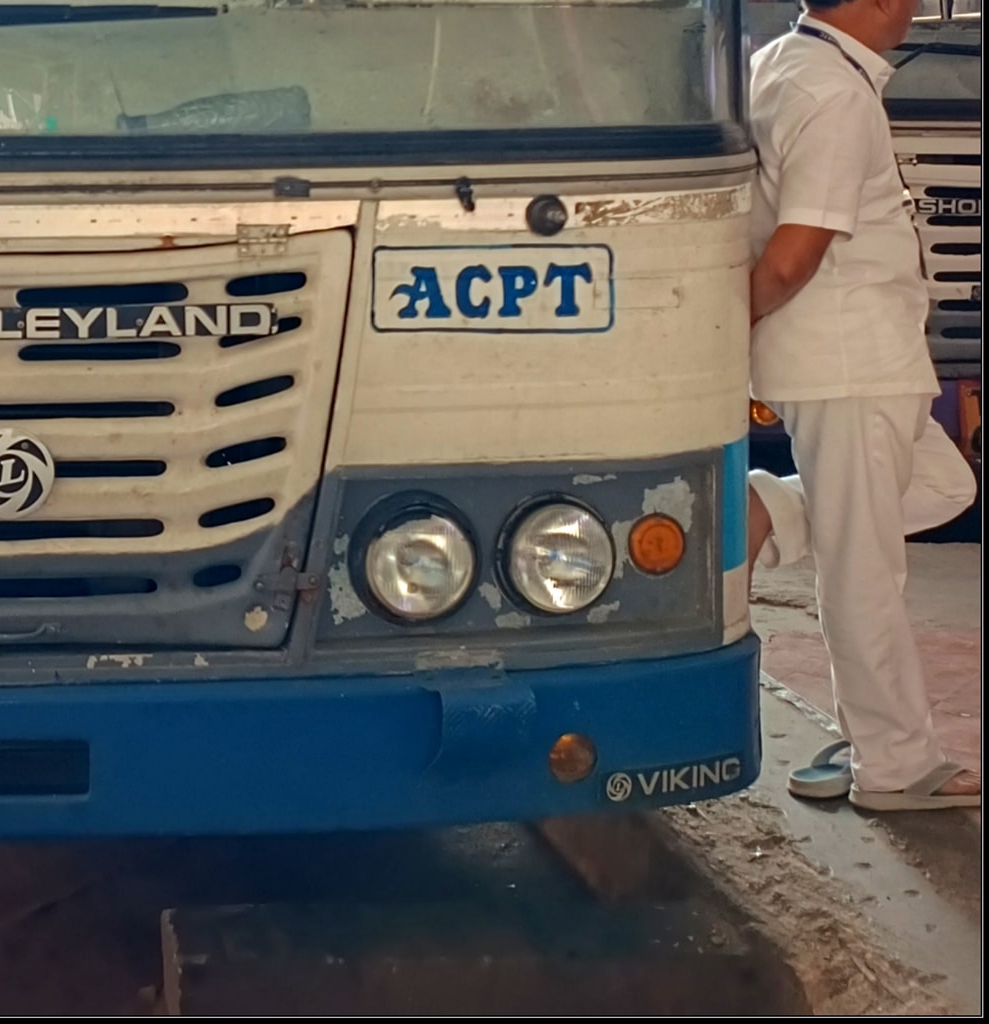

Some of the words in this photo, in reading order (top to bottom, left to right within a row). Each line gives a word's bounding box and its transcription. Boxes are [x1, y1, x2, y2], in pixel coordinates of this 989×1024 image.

[917, 197, 981, 215] SHO
[388, 262, 593, 319] ACPT
[637, 757, 741, 796] VIKING
